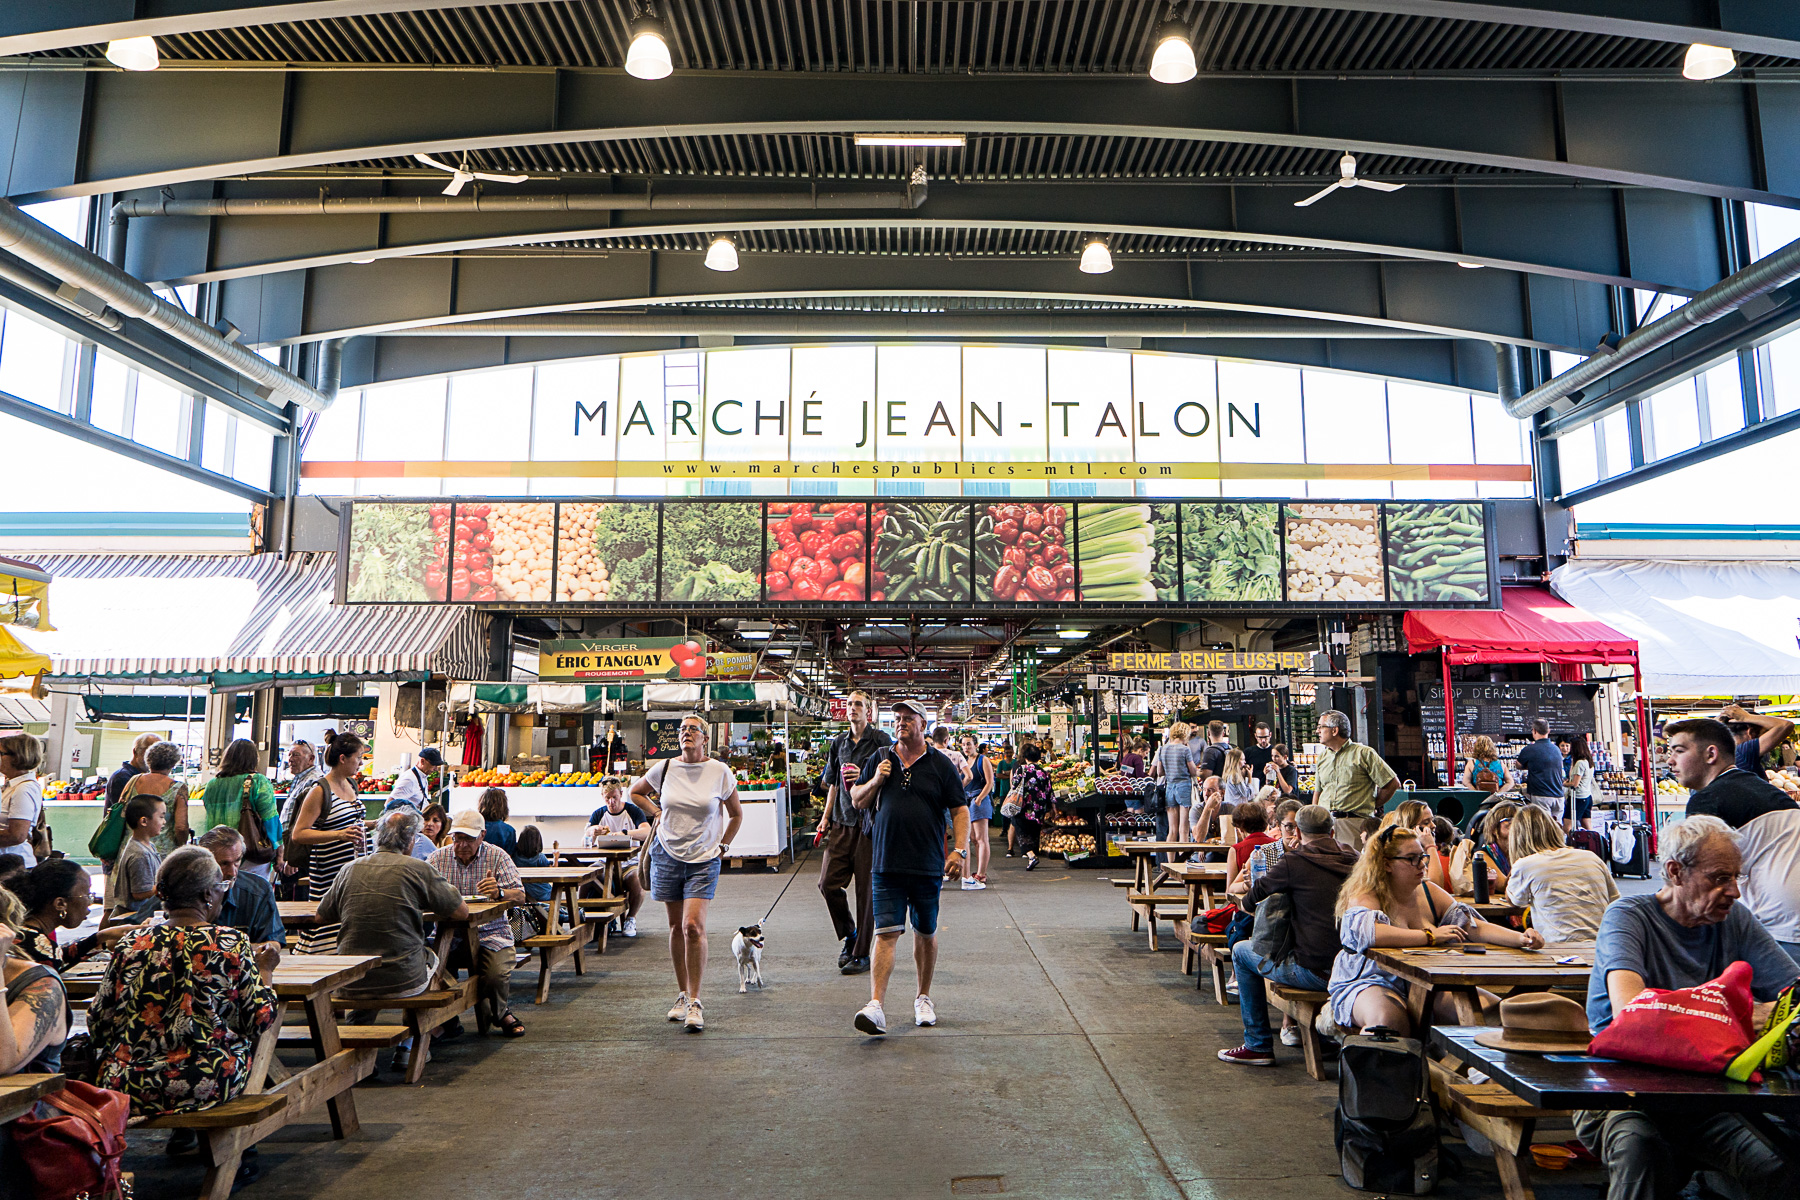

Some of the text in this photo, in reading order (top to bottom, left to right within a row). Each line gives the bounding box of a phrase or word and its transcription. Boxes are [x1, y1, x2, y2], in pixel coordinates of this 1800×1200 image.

[574, 390, 1261, 448] MARCHÉ JEAN-TALON
[663, 462, 1173, 478] www.marchespublics-mtl.com
[581, 642, 639, 652] VERGER
[556, 653, 663, 669] ÉRIC TANGUAY
[715, 657, 725, 666] DE
[726, 654, 753, 665] POMME
[741, 663, 753, 671] PUR
[1111, 652, 1305, 669] FERME RENE LUSSIER
[1097, 675, 1278, 694] PETITS FRUITS DU QC
